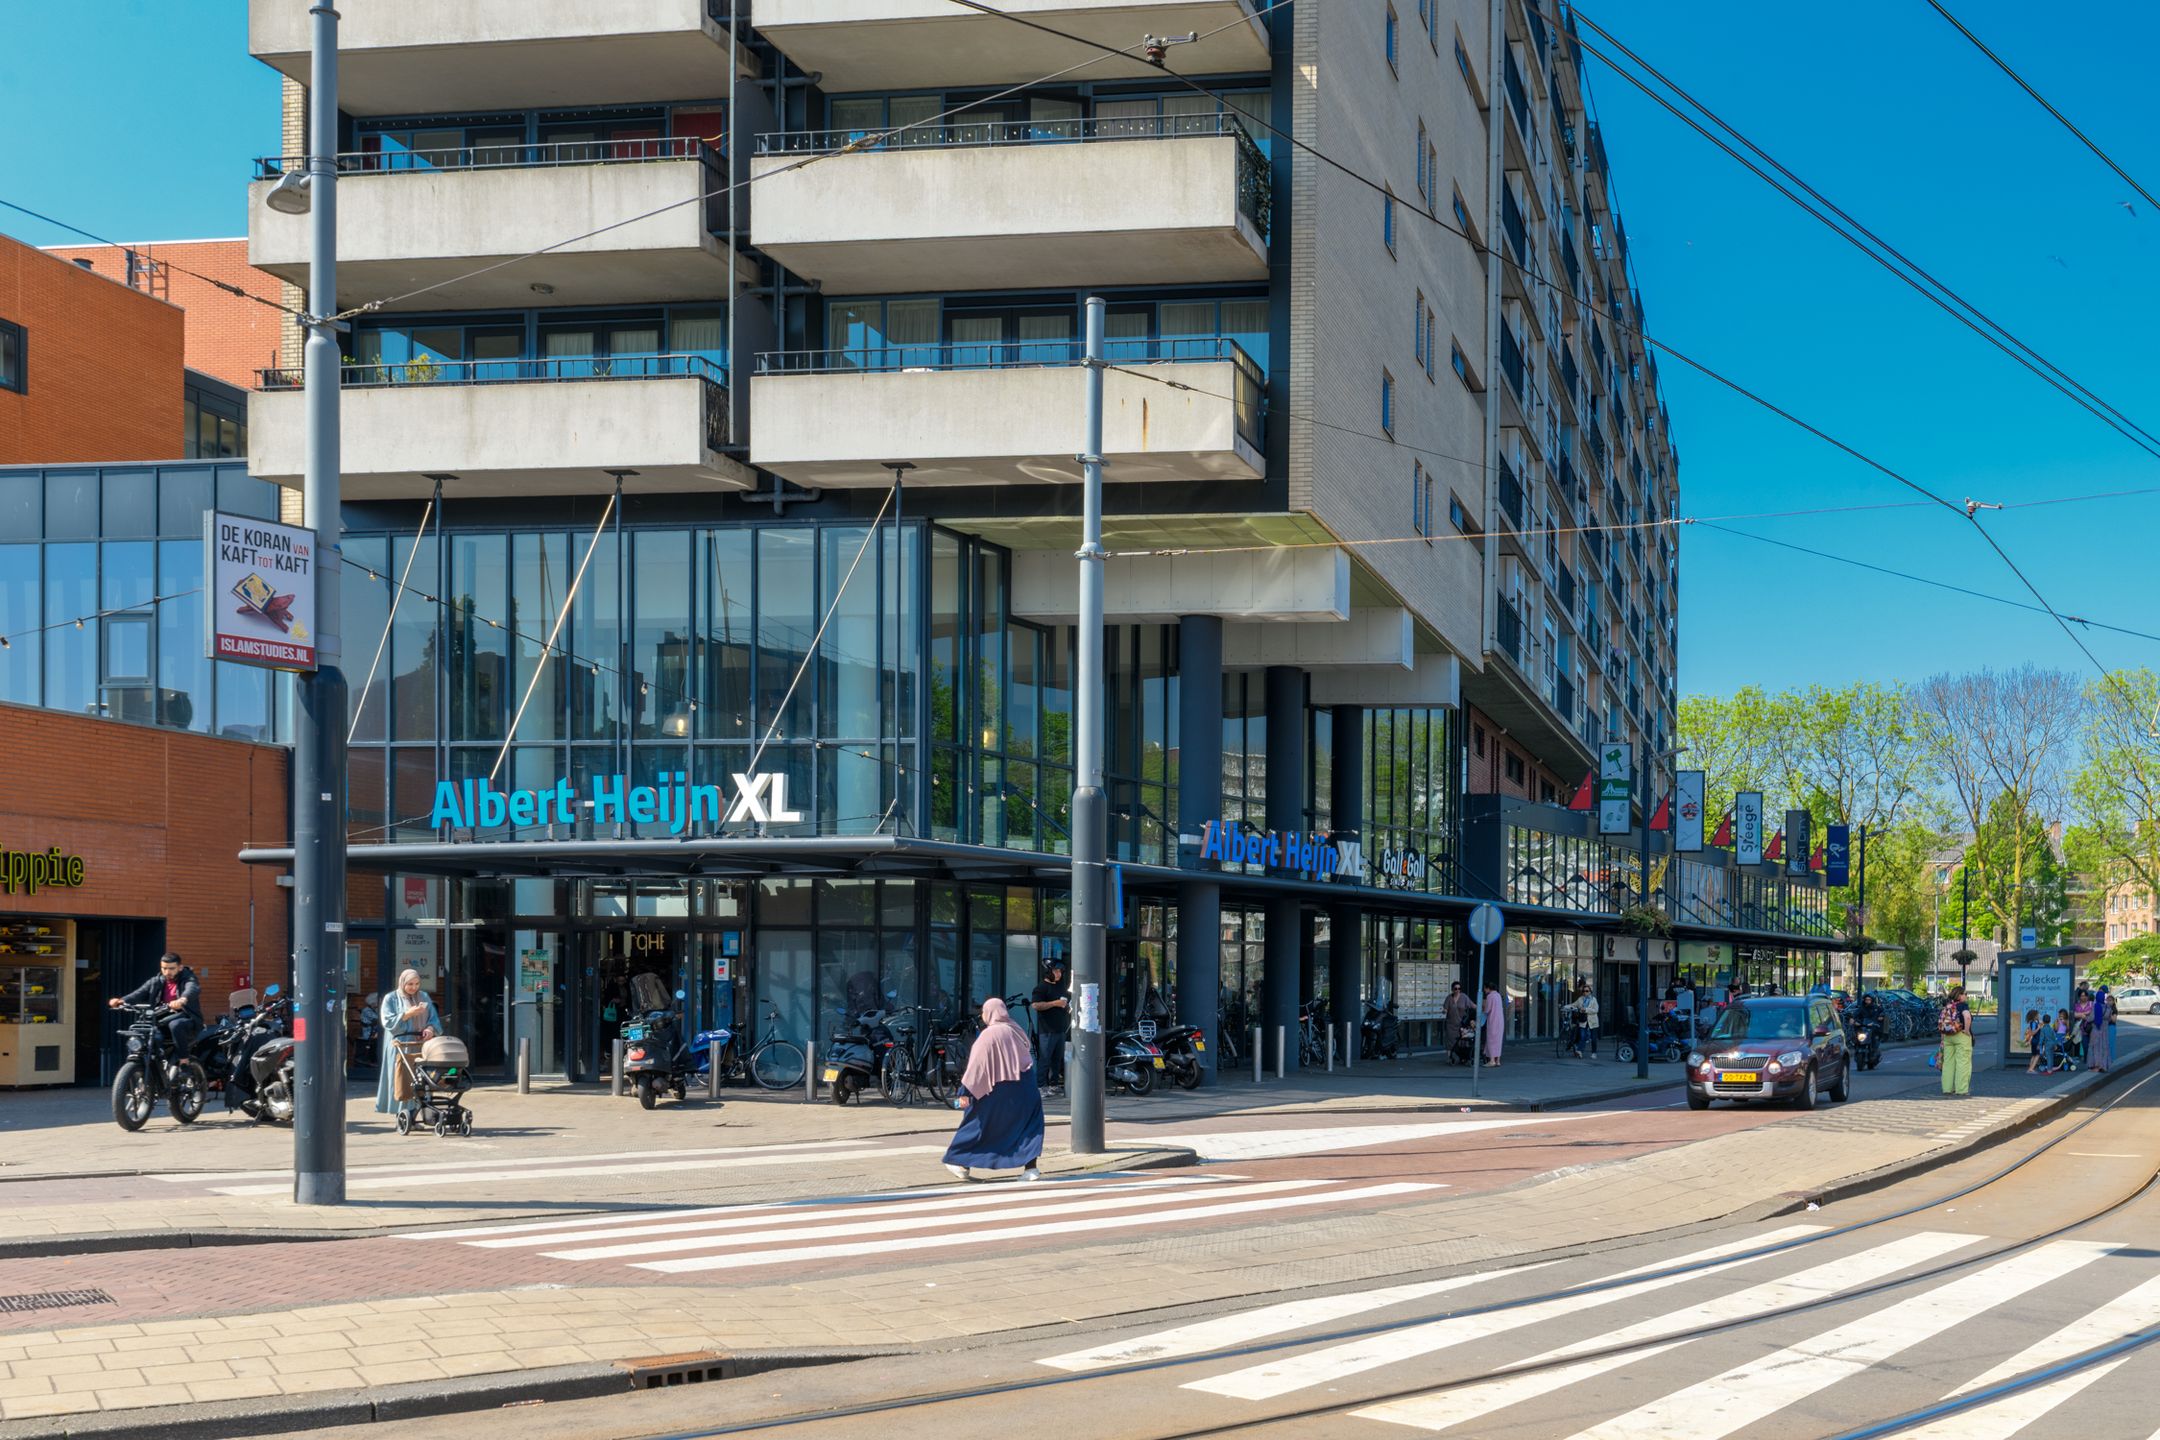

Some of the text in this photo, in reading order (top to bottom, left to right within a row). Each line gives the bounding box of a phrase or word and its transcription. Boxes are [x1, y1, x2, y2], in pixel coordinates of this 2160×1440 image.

[222, 524, 309, 556] DE KORAN VAN
[221, 544, 309, 575] KAFT TOT KAFT
[221, 637, 310, 663] ISLAMSTUDIES.NL
[431, 771, 805, 835] Albert Heijn XL
[1200, 819, 1366, 882] Albert Heijn XL
[2019, 974, 2030, 984] Zo
